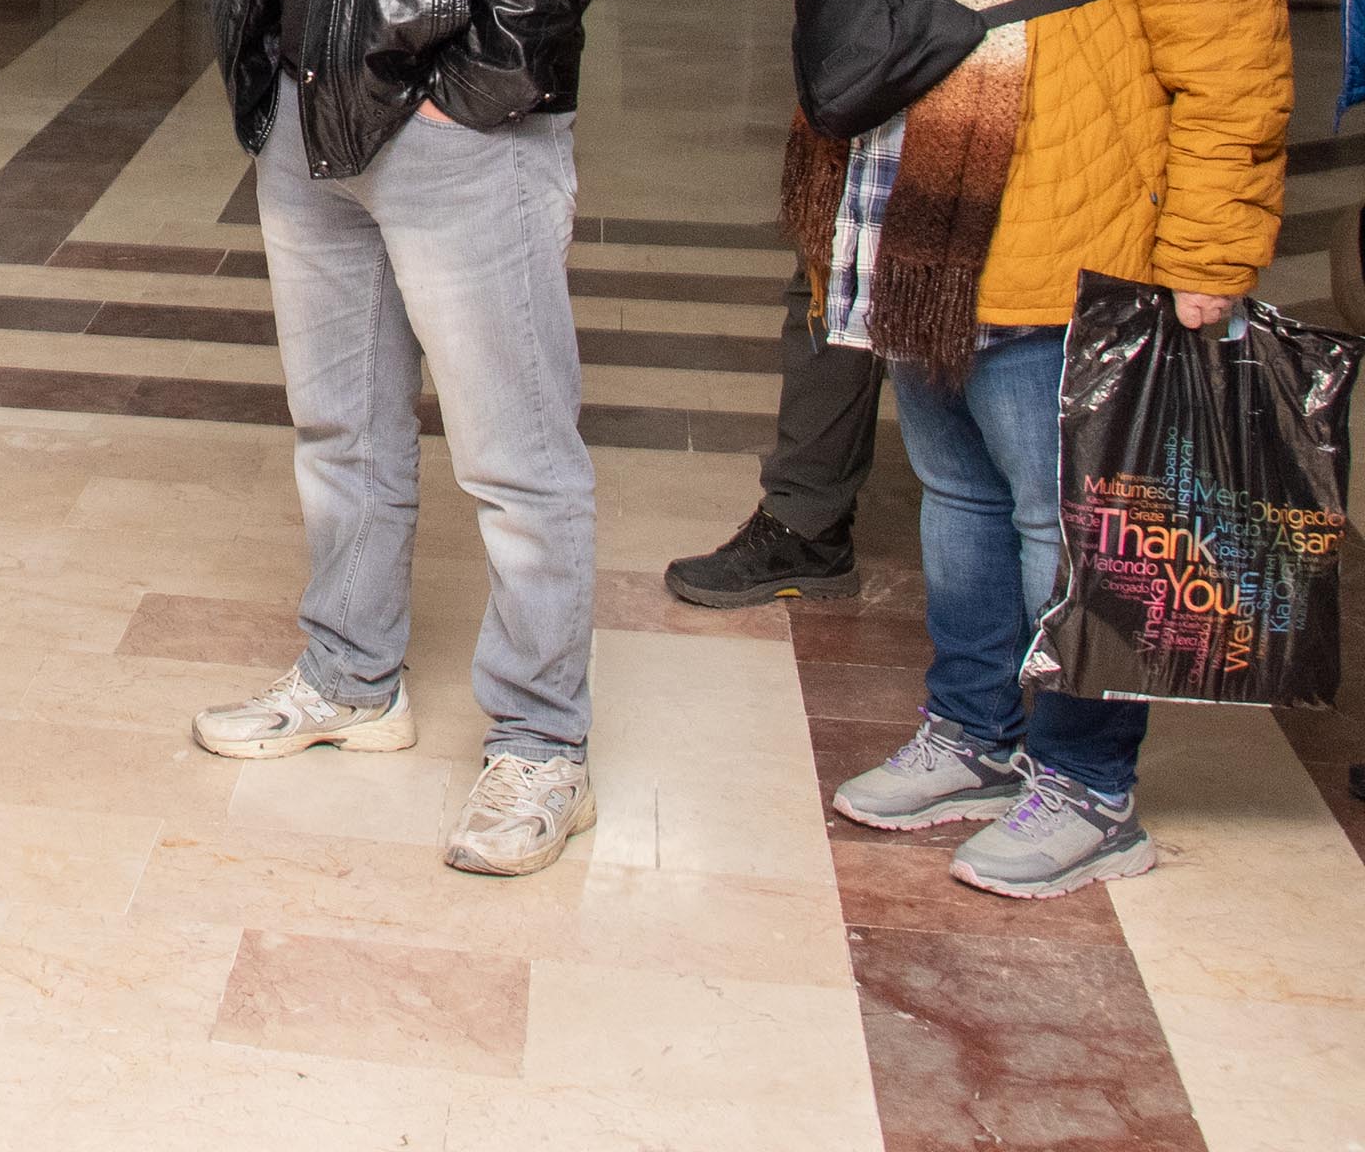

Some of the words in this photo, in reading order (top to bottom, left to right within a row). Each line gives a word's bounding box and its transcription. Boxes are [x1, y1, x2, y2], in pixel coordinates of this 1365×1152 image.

[1162, 425, 1179, 486] Spasibo
[1084, 473, 1176, 502] Multumesc
[1094, 506, 1217, 565] Thank
[1077, 551, 1160, 577] Matondo
[1163, 562, 1241, 617] You
